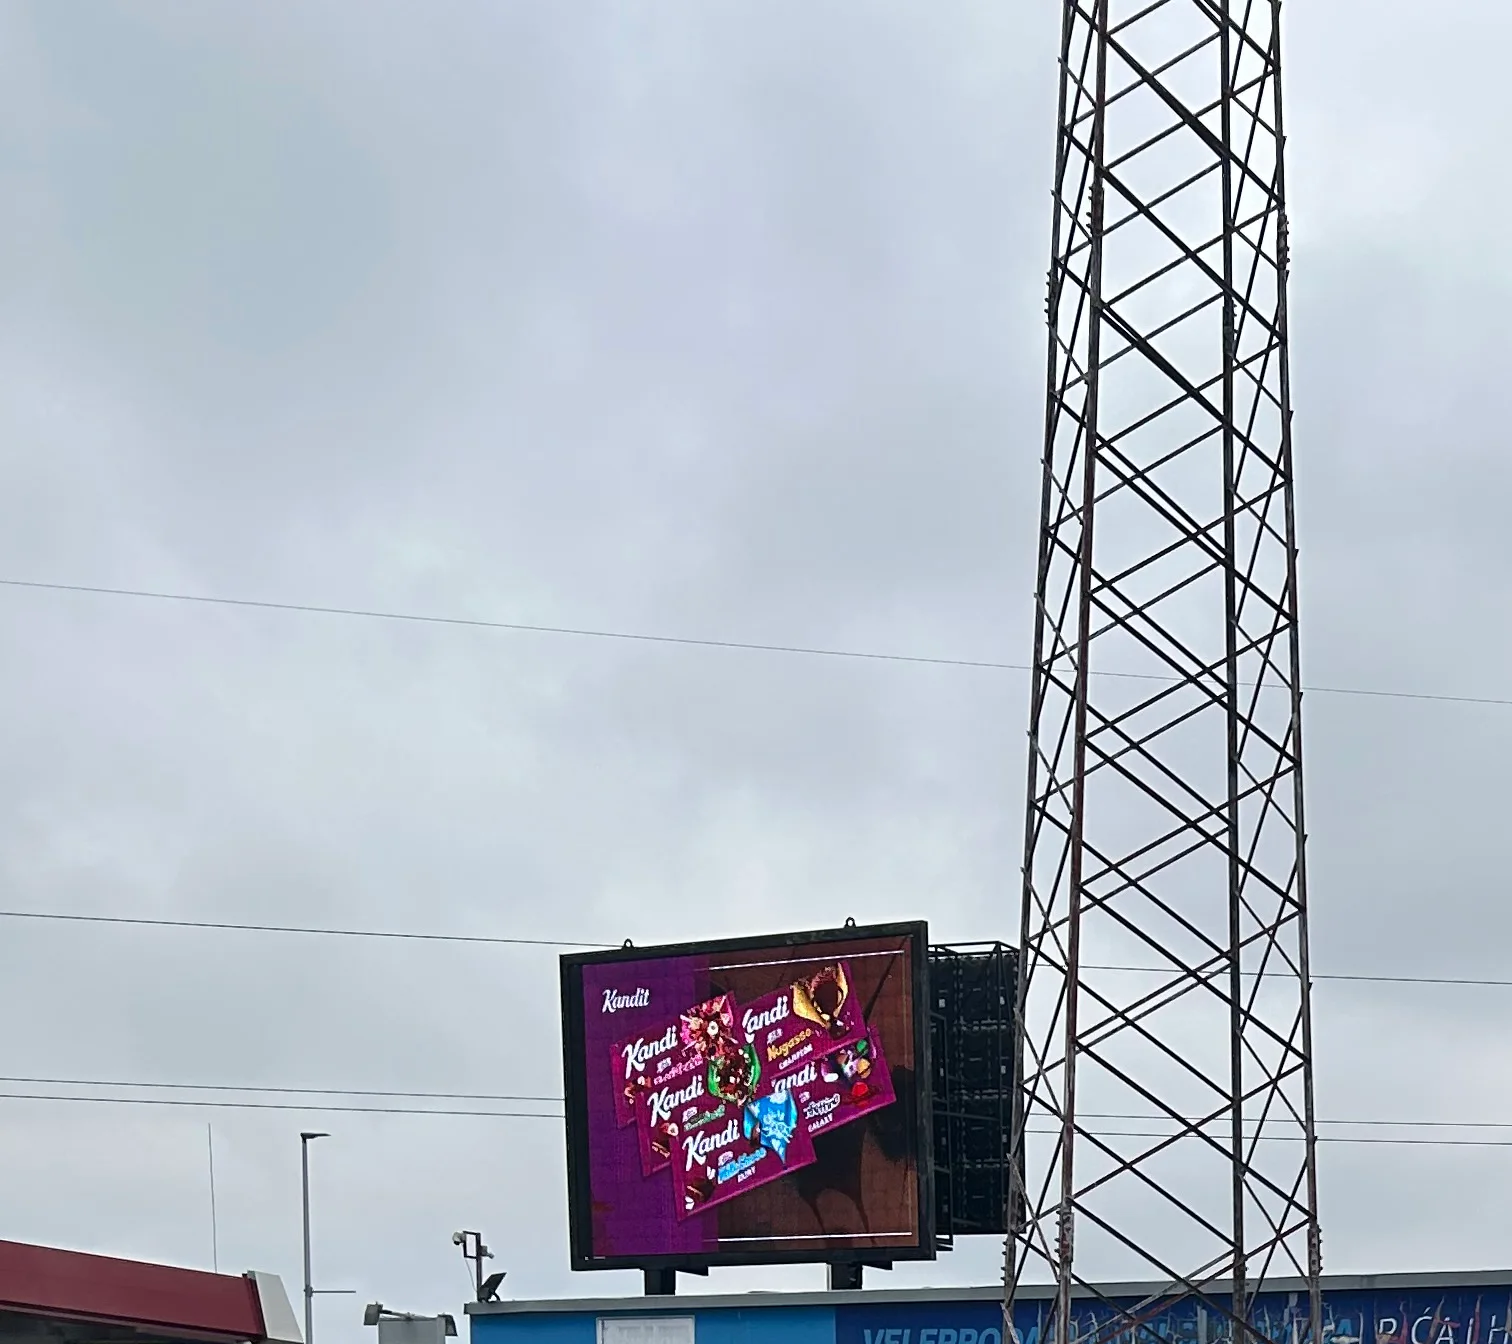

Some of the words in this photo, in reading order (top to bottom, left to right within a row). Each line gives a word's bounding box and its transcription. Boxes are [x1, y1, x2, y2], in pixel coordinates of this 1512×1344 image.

[602, 987, 650, 1013] Kandit
[621, 1025, 679, 1079] Kandi
[771, 1061, 818, 1094] andi
[647, 1074, 705, 1127] Kandi
[682, 1118, 741, 1171] Kandi
